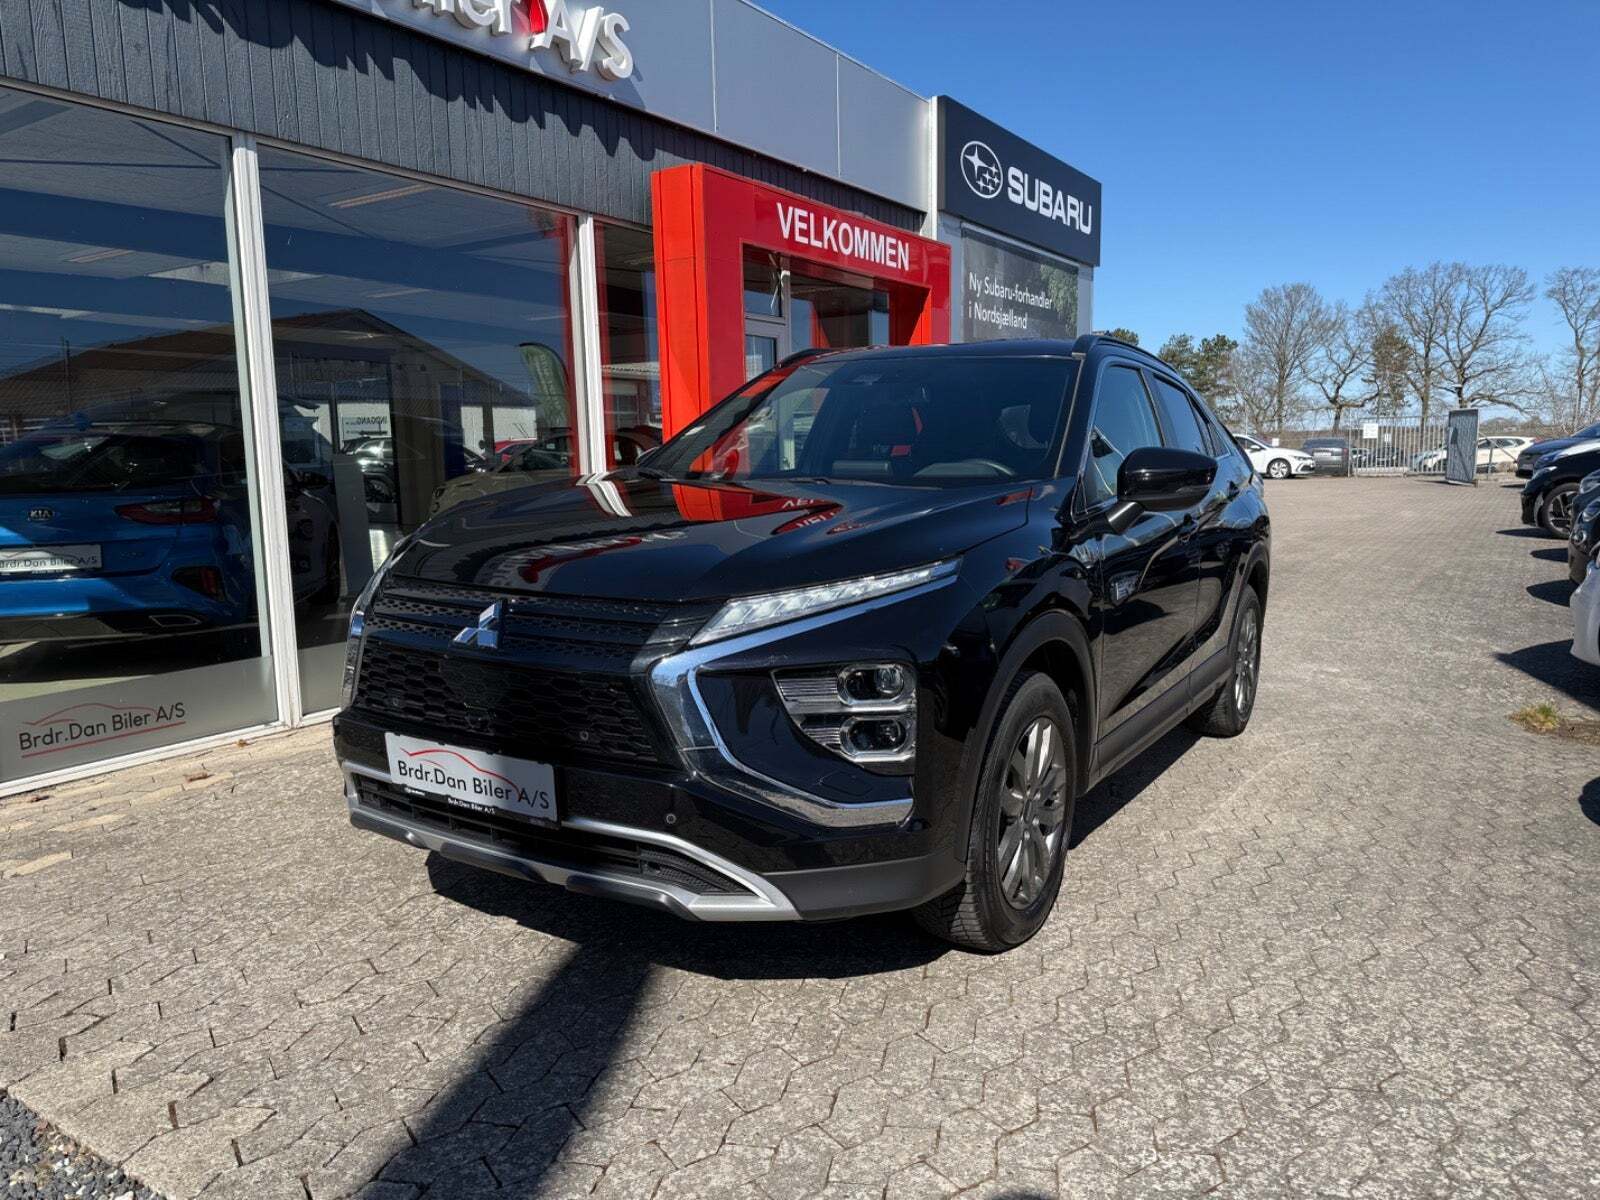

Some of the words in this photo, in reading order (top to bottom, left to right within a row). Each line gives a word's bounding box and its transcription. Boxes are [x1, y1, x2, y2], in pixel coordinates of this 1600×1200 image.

[528, 0, 635, 80] A/S
[1007, 165, 1093, 236] SUBARU
[776, 202, 910, 271] VELKOMMEN
[968, 300, 972, 319] i
[974, 301, 1028, 330] Nordsjælland
[969, 271, 982, 297] Ny
[984, 276, 1053, 310] Subaru-forhandler
[30, 509, 51, 518] KIA
[19, 722, 107, 750] Brdr.Dan
[112, 712, 151, 731] Biler
[156, 702, 186, 723] A/S
[398, 760, 467, 792] Brdr.Dan
[473, 778, 512, 801] Biler
[518, 788, 550, 810] A/S
